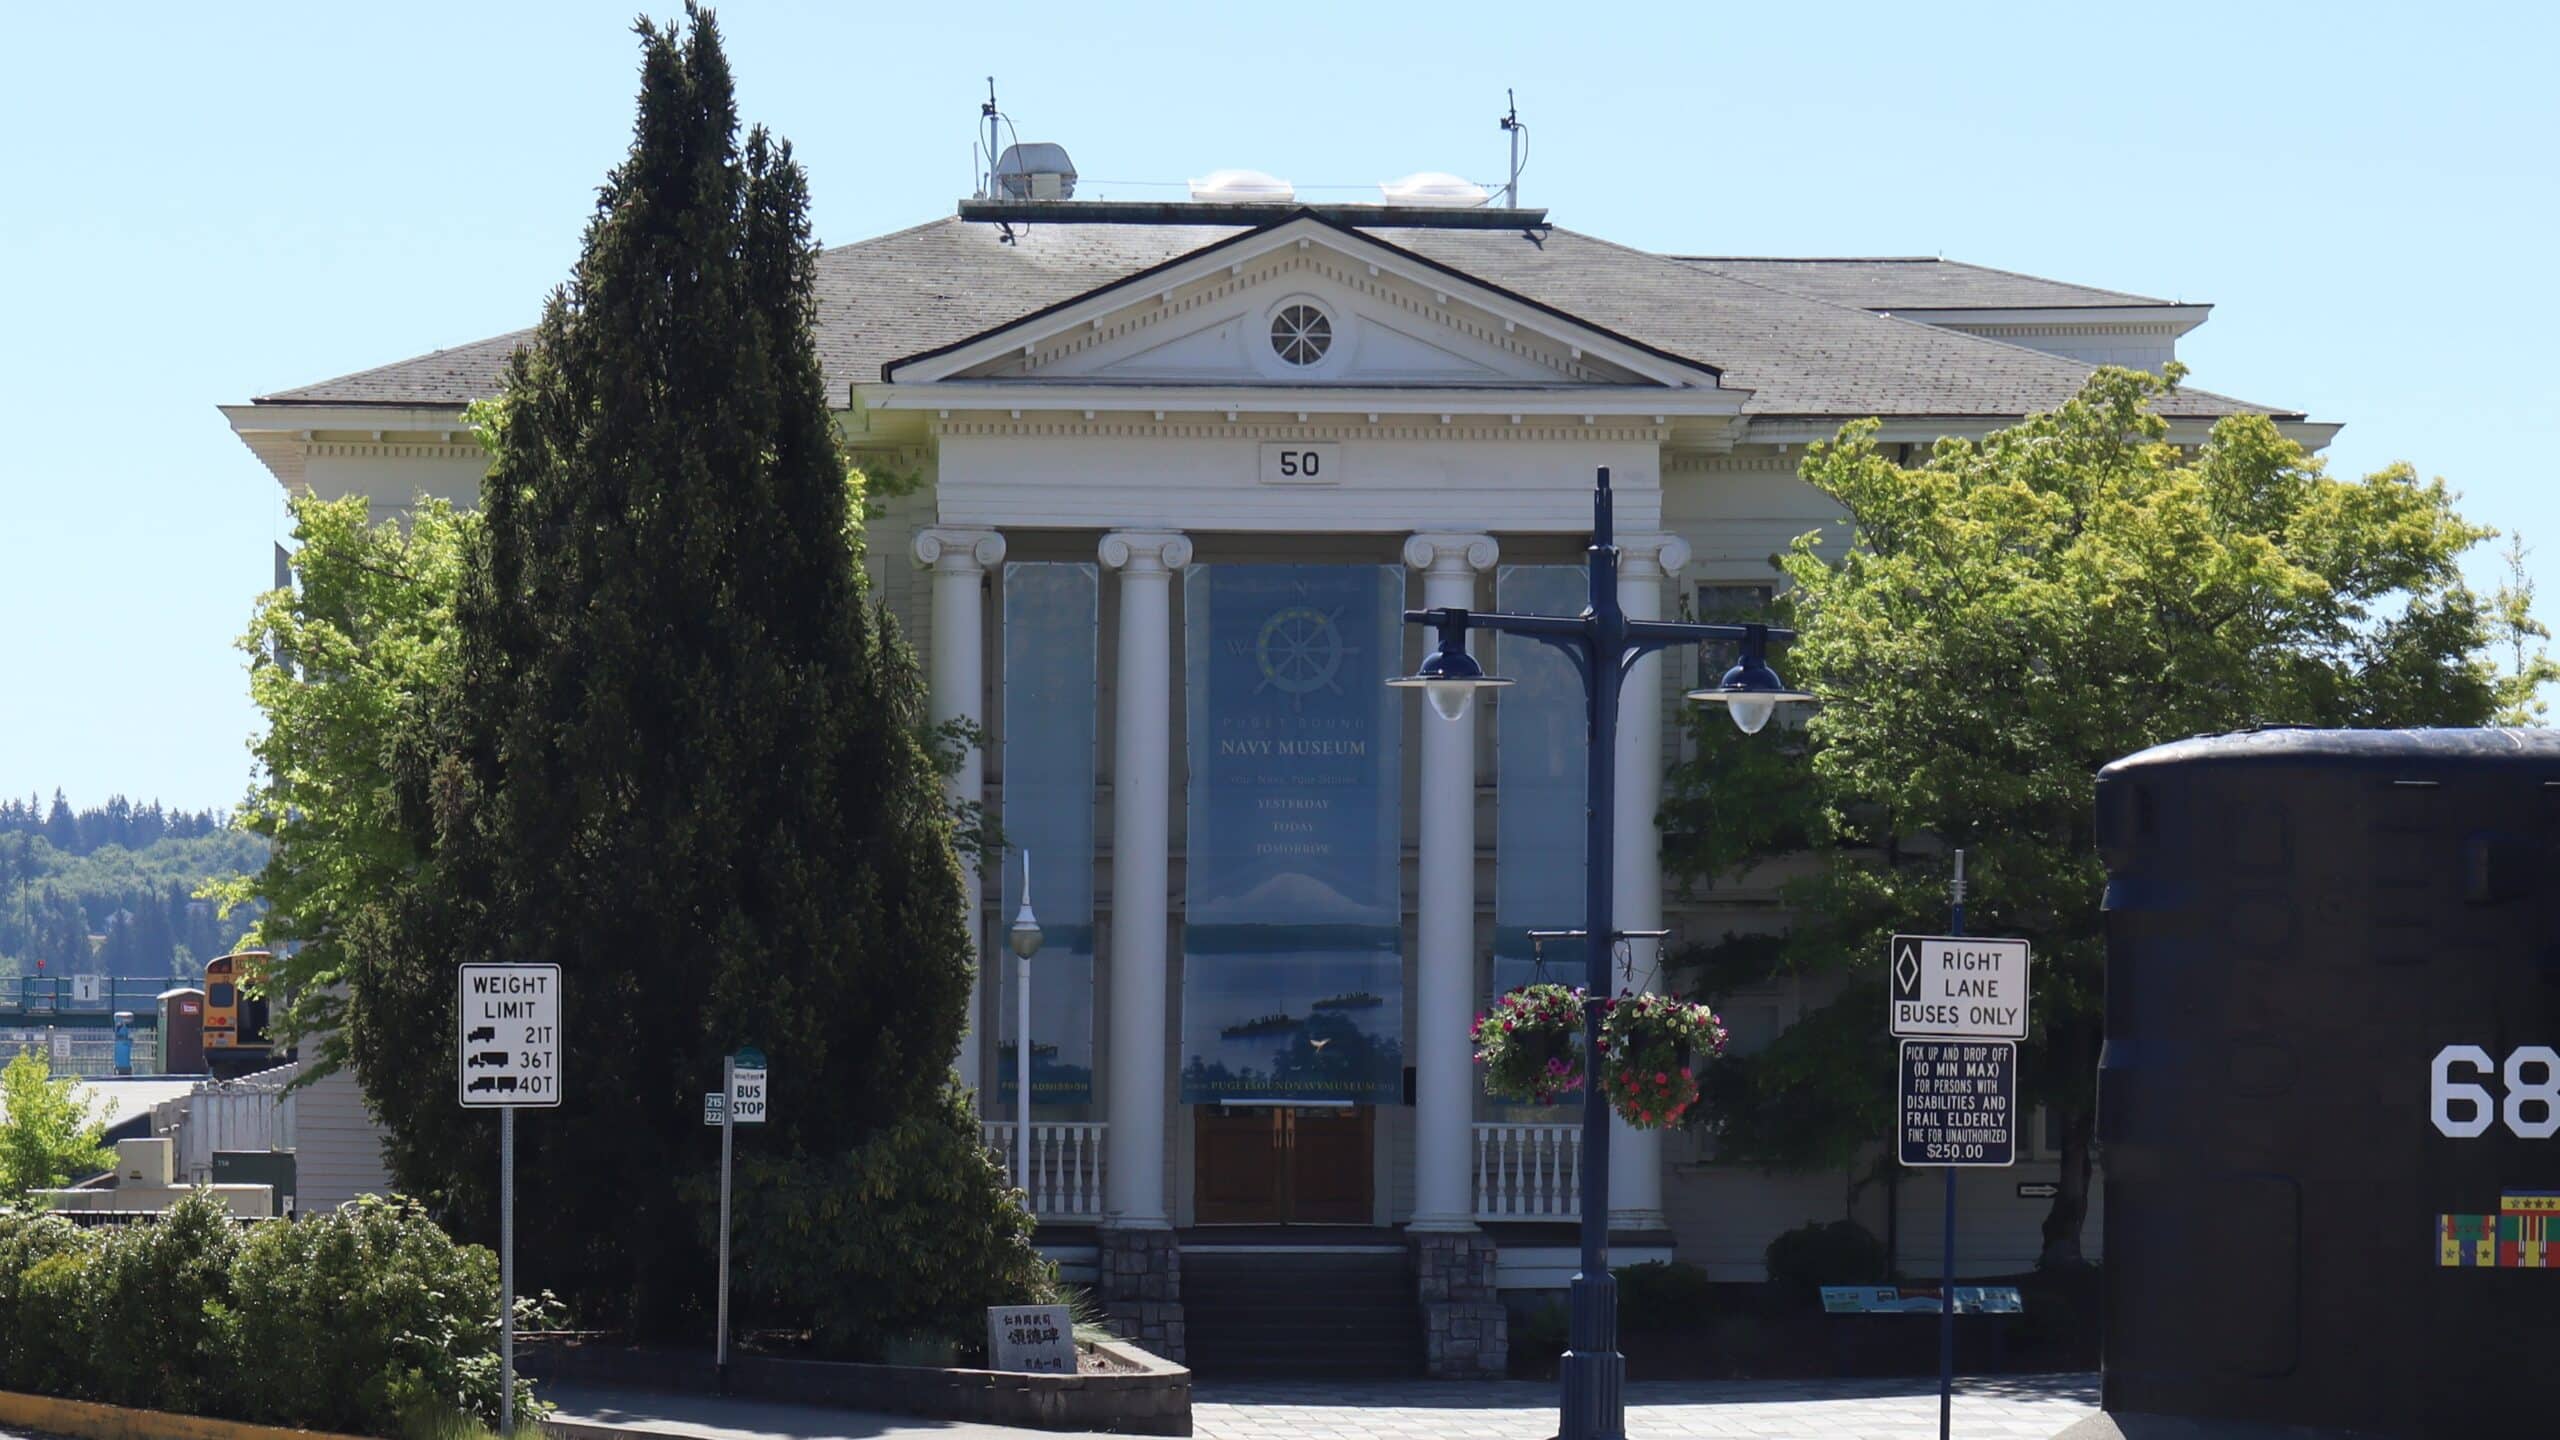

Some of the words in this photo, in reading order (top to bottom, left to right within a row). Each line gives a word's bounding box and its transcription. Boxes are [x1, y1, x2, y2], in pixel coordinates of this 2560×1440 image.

[1281, 451, 1319, 476] 50
[1221, 739, 1272, 755] NAVY
[1279, 739, 1366, 756] MUSEUM
[1257, 799, 1329, 809] YESTERDAY
[1272, 822, 1313, 832] TODAY
[1256, 843, 1329, 854] TOMORROW
[1943, 951, 2002, 971] RIGHT
[473, 976, 547, 994] WEIGHT
[1945, 980, 1999, 998] LANE
[485, 1002, 535, 1018] LIMIT
[1900, 1005, 1960, 1024] BUSES
[1970, 1007, 2017, 1025] ONLY
[525, 1027, 552, 1044] 21T
[520, 1052, 552, 1069] 36T
[1906, 1047, 1923, 1061] PICK
[1928, 1047, 1939, 1061] UP
[1943, 1048, 1959, 1061] AND
[1964, 1048, 1988, 1062] DROP
[1992, 1048, 2009, 1062] OFF
[1936, 1062, 1957, 1077] MIN
[1966, 1062, 2000, 1078] MAX)
[519, 1076, 552, 1093] 40T
[737, 1085, 760, 1098] BUS
[1915, 1079, 1930, 1093] FOR
[1934, 1079, 1972, 1094] PERSONS
[1977, 1080, 1998, 1094] WITH
[2431, 1045, 2560, 1138] 68
[733, 1101, 764, 1114] STOP
[1907, 1096, 1975, 1110] DISABILITIES
[1982, 1096, 2006, 1110] AND
[1907, 1113, 1940, 1126] FRAIL
[1948, 1113, 2006, 1127] ELDERLY
[1908, 1129, 1924, 1143] FINE
[1928, 1129, 1942, 1143] FOR
[1946, 1129, 2006, 1143] UNAUTHORIZED
[1927, 1144, 1983, 1159] $250.00
